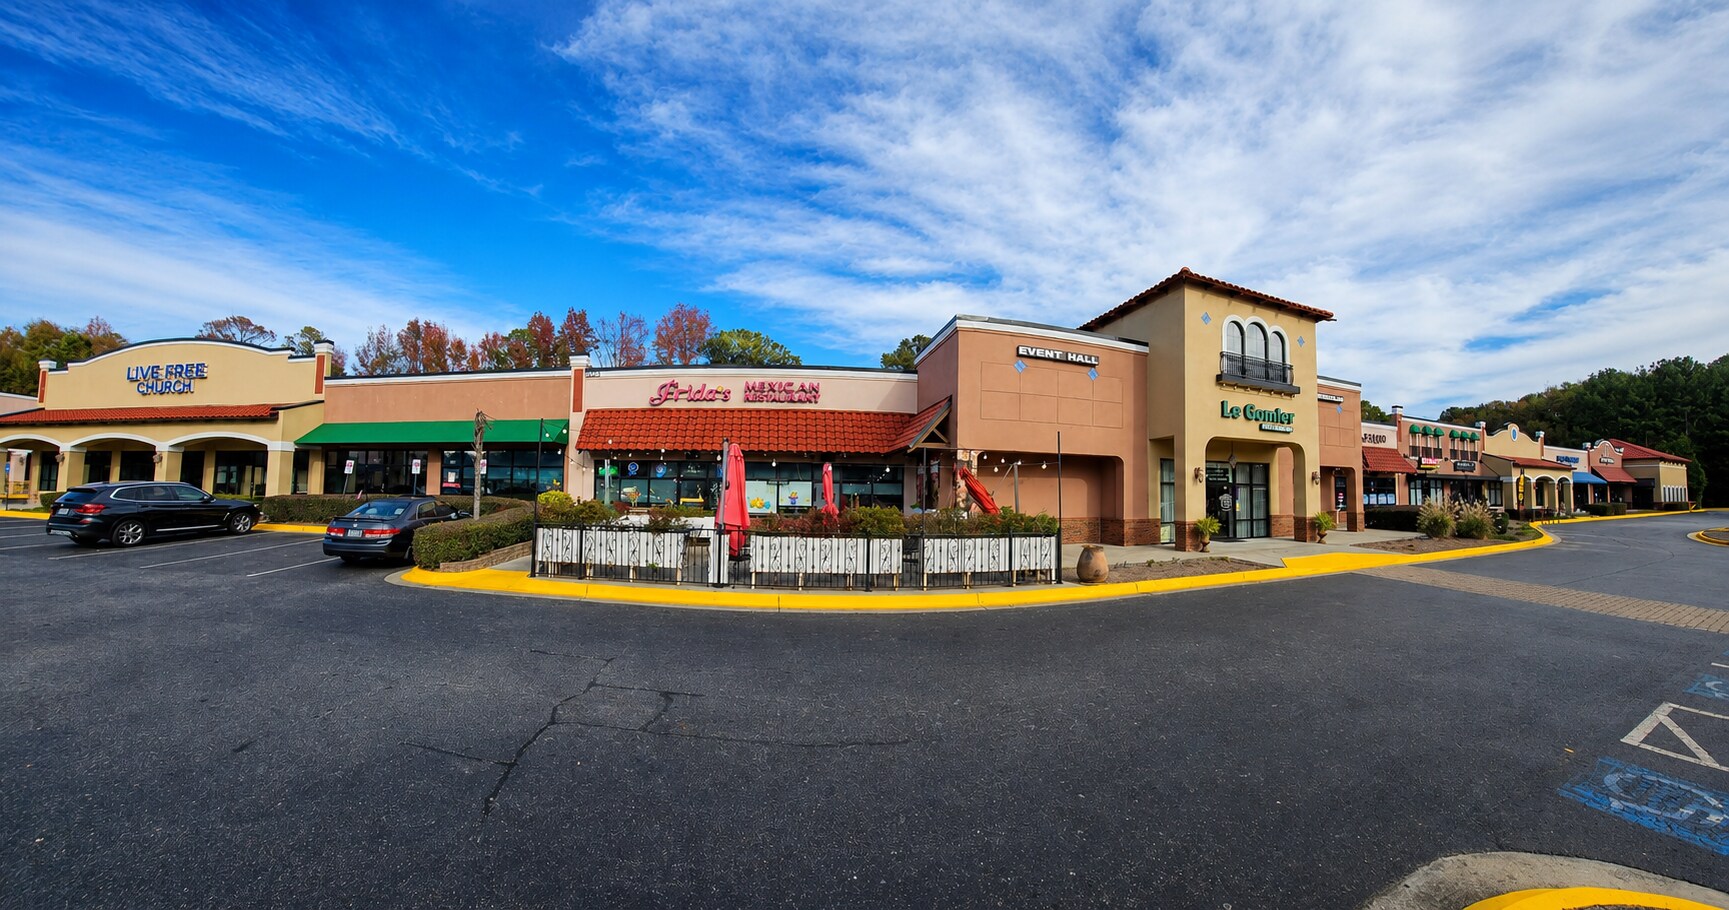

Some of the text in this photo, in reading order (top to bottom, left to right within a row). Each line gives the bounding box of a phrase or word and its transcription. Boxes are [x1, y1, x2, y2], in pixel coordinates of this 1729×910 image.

[1018, 346, 1099, 365] EVENT HALL
[127, 363, 207, 381] LIVE FREE
[136, 380, 193, 395] CHURCH
[649, 379, 731, 407] Frida's
[744, 381, 820, 393] MEXICAN
[1221, 400, 1242, 419] Le
